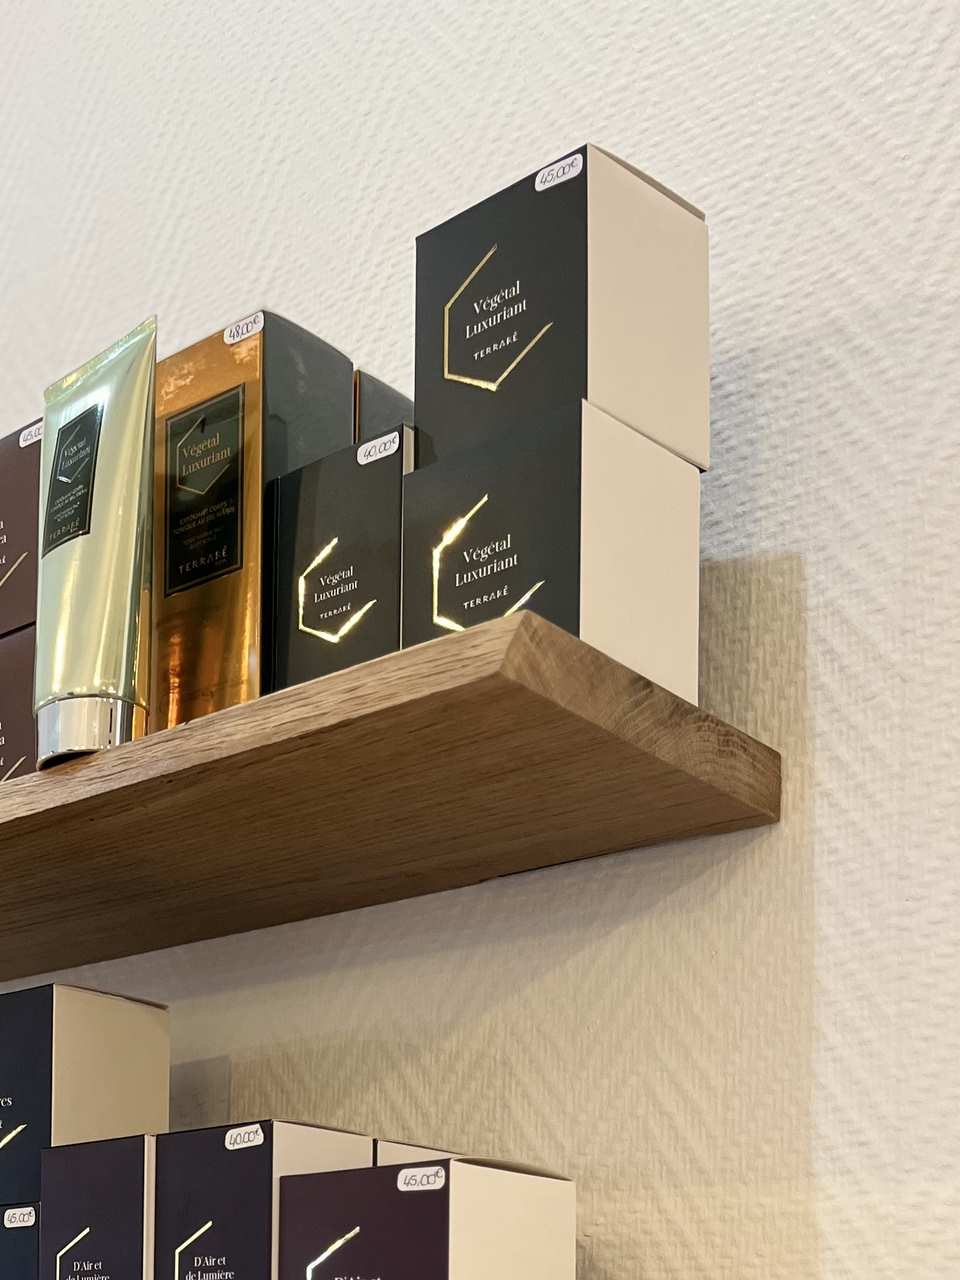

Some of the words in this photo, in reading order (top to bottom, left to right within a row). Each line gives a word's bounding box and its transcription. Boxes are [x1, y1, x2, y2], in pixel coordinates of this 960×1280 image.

[473, 280, 520, 314] Végétal
[466, 299, 527, 339] Luxuriant
[183, 432, 221, 459] Végétal
[182, 447, 231, 477] Luxuriant
[463, 534, 511, 563] Végétal
[319, 565, 353, 588] Végétal
[455, 554, 518, 587] Luxuriant
[314, 580, 358, 604] Luxuriant
[73, 1261, 94, 1272] D'Air
[95, 1260, 102, 1271] et
[194, 1256, 217, 1268] D'Air
[217, 1256, 226, 1266] et
[198, 1269, 235, 1280] Lumière
